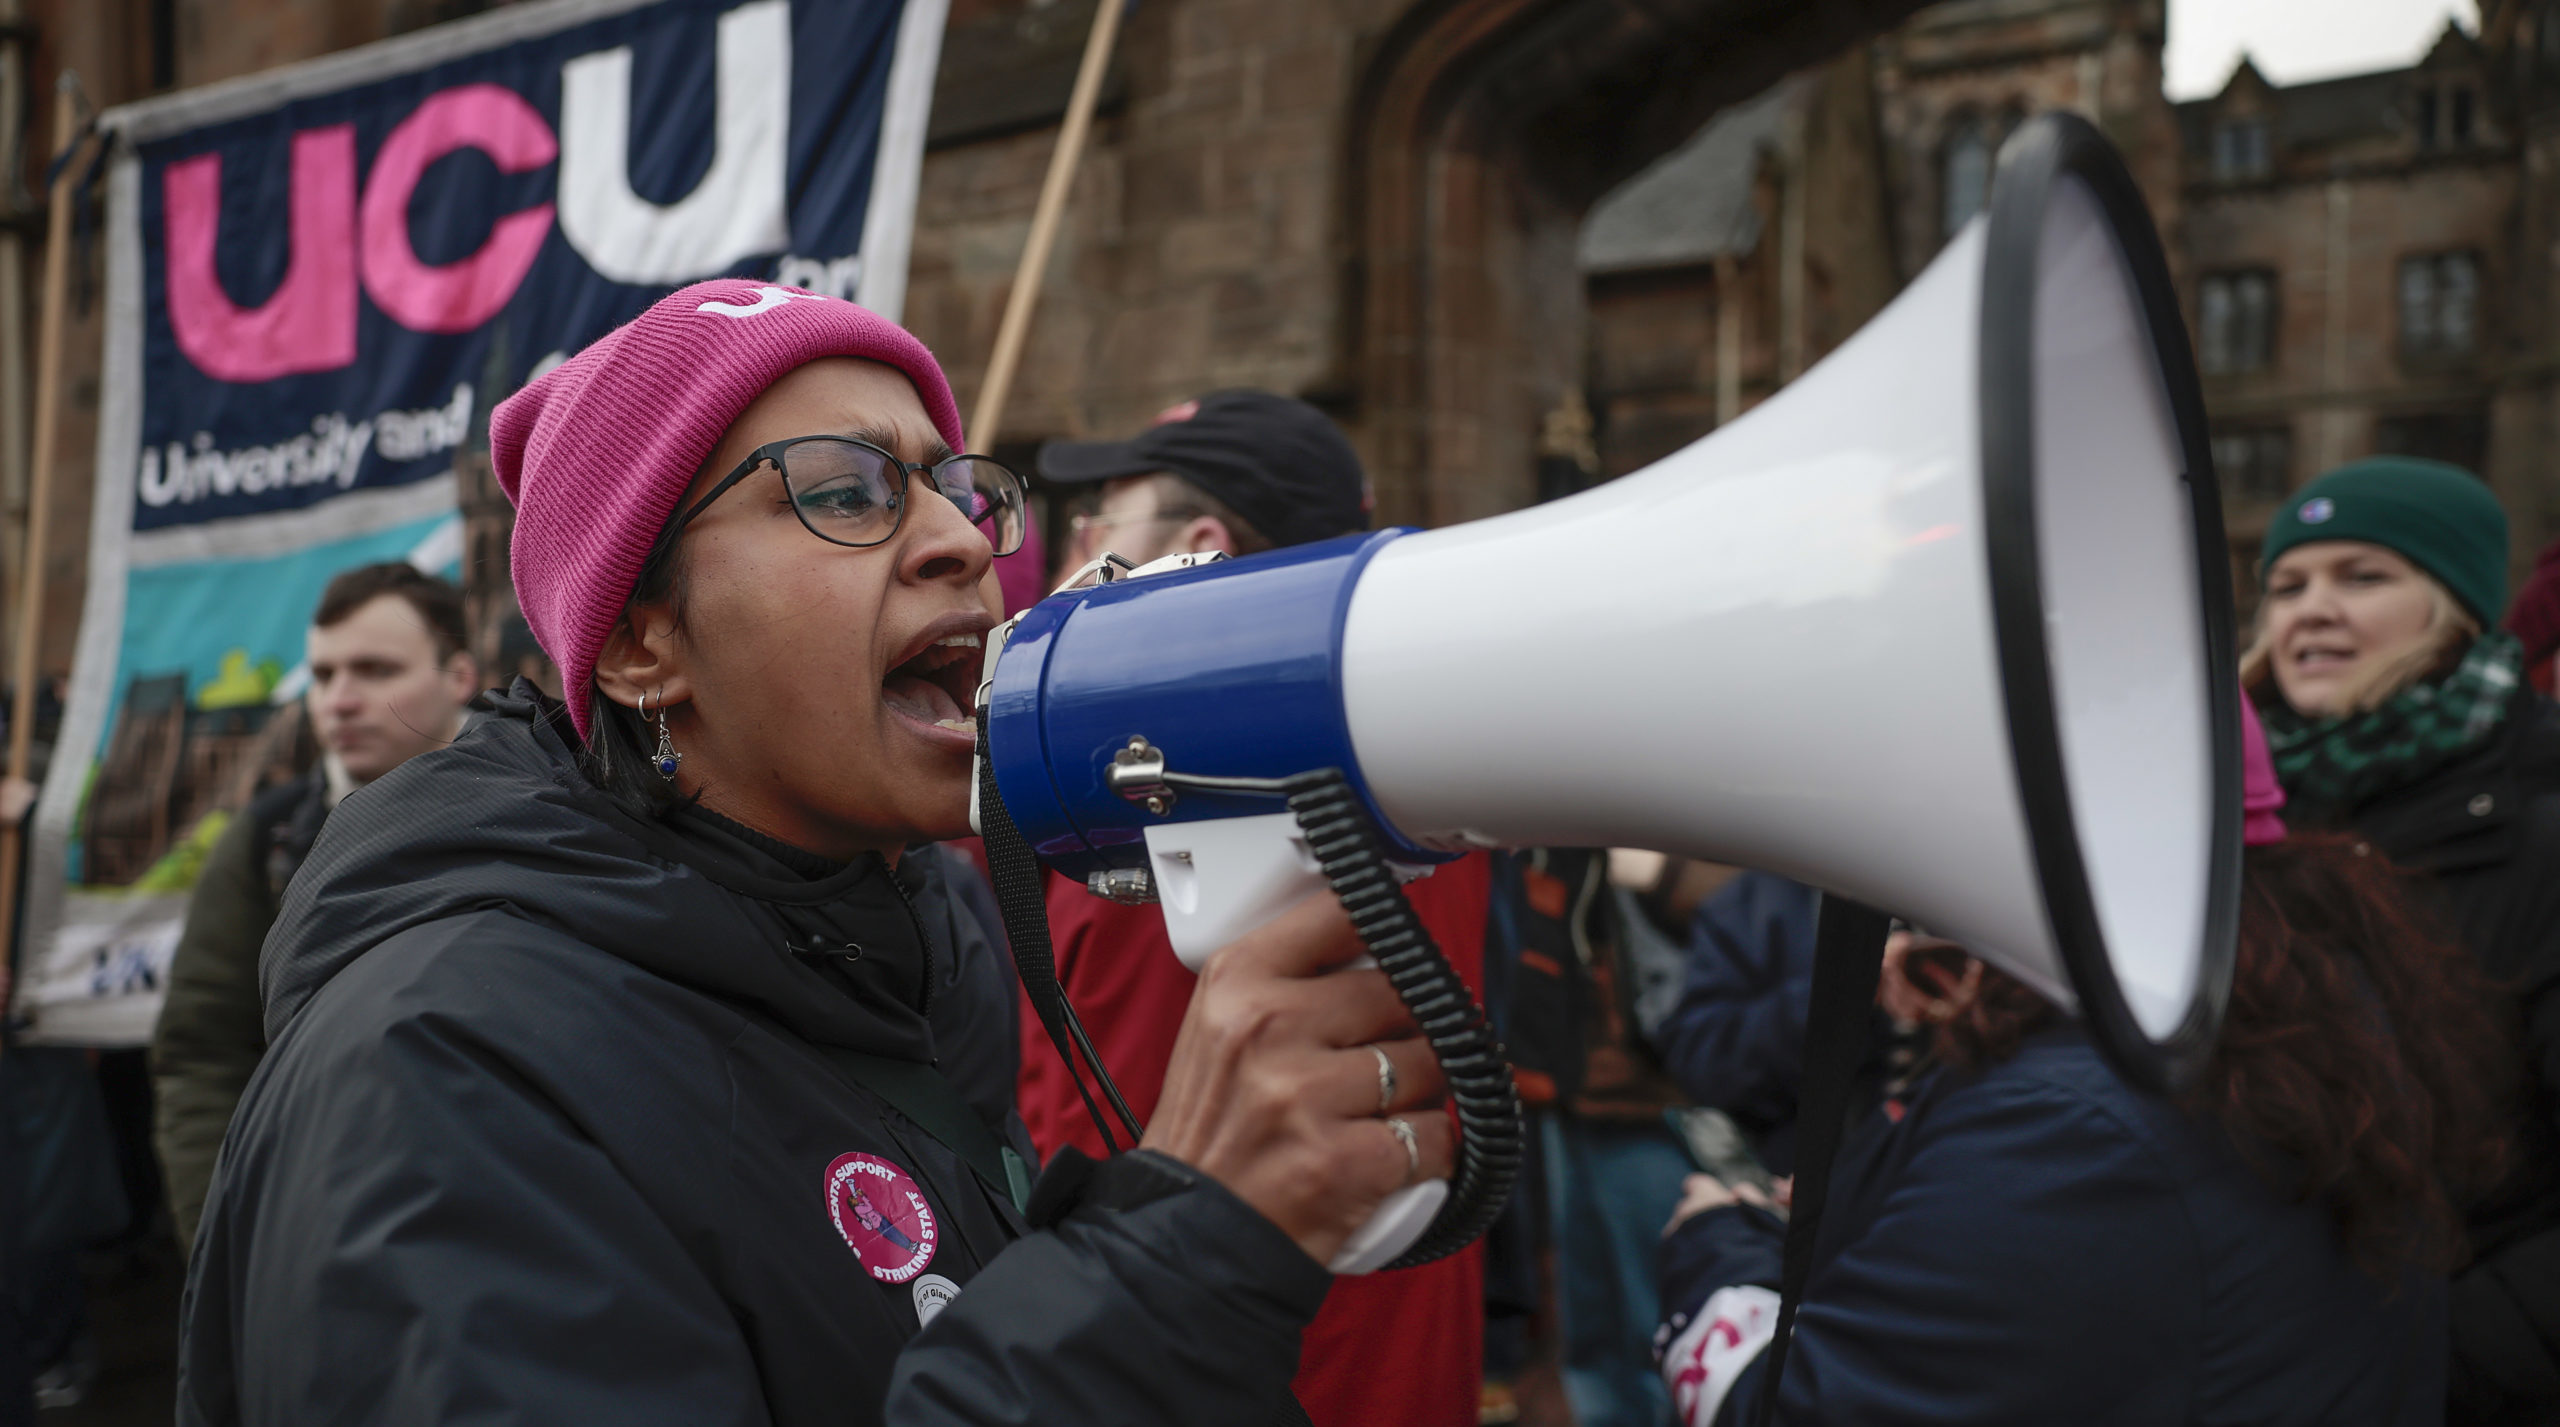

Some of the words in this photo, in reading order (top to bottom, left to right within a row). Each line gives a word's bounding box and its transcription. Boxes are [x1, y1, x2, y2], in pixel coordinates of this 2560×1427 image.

[375, 382, 474, 461] and
[835, 1161, 897, 1182] SUPPORT
[873, 1242, 933, 1281] STRIKING
[905, 1191, 935, 1240] STAFF
[922, 1289, 930, 1301] of
